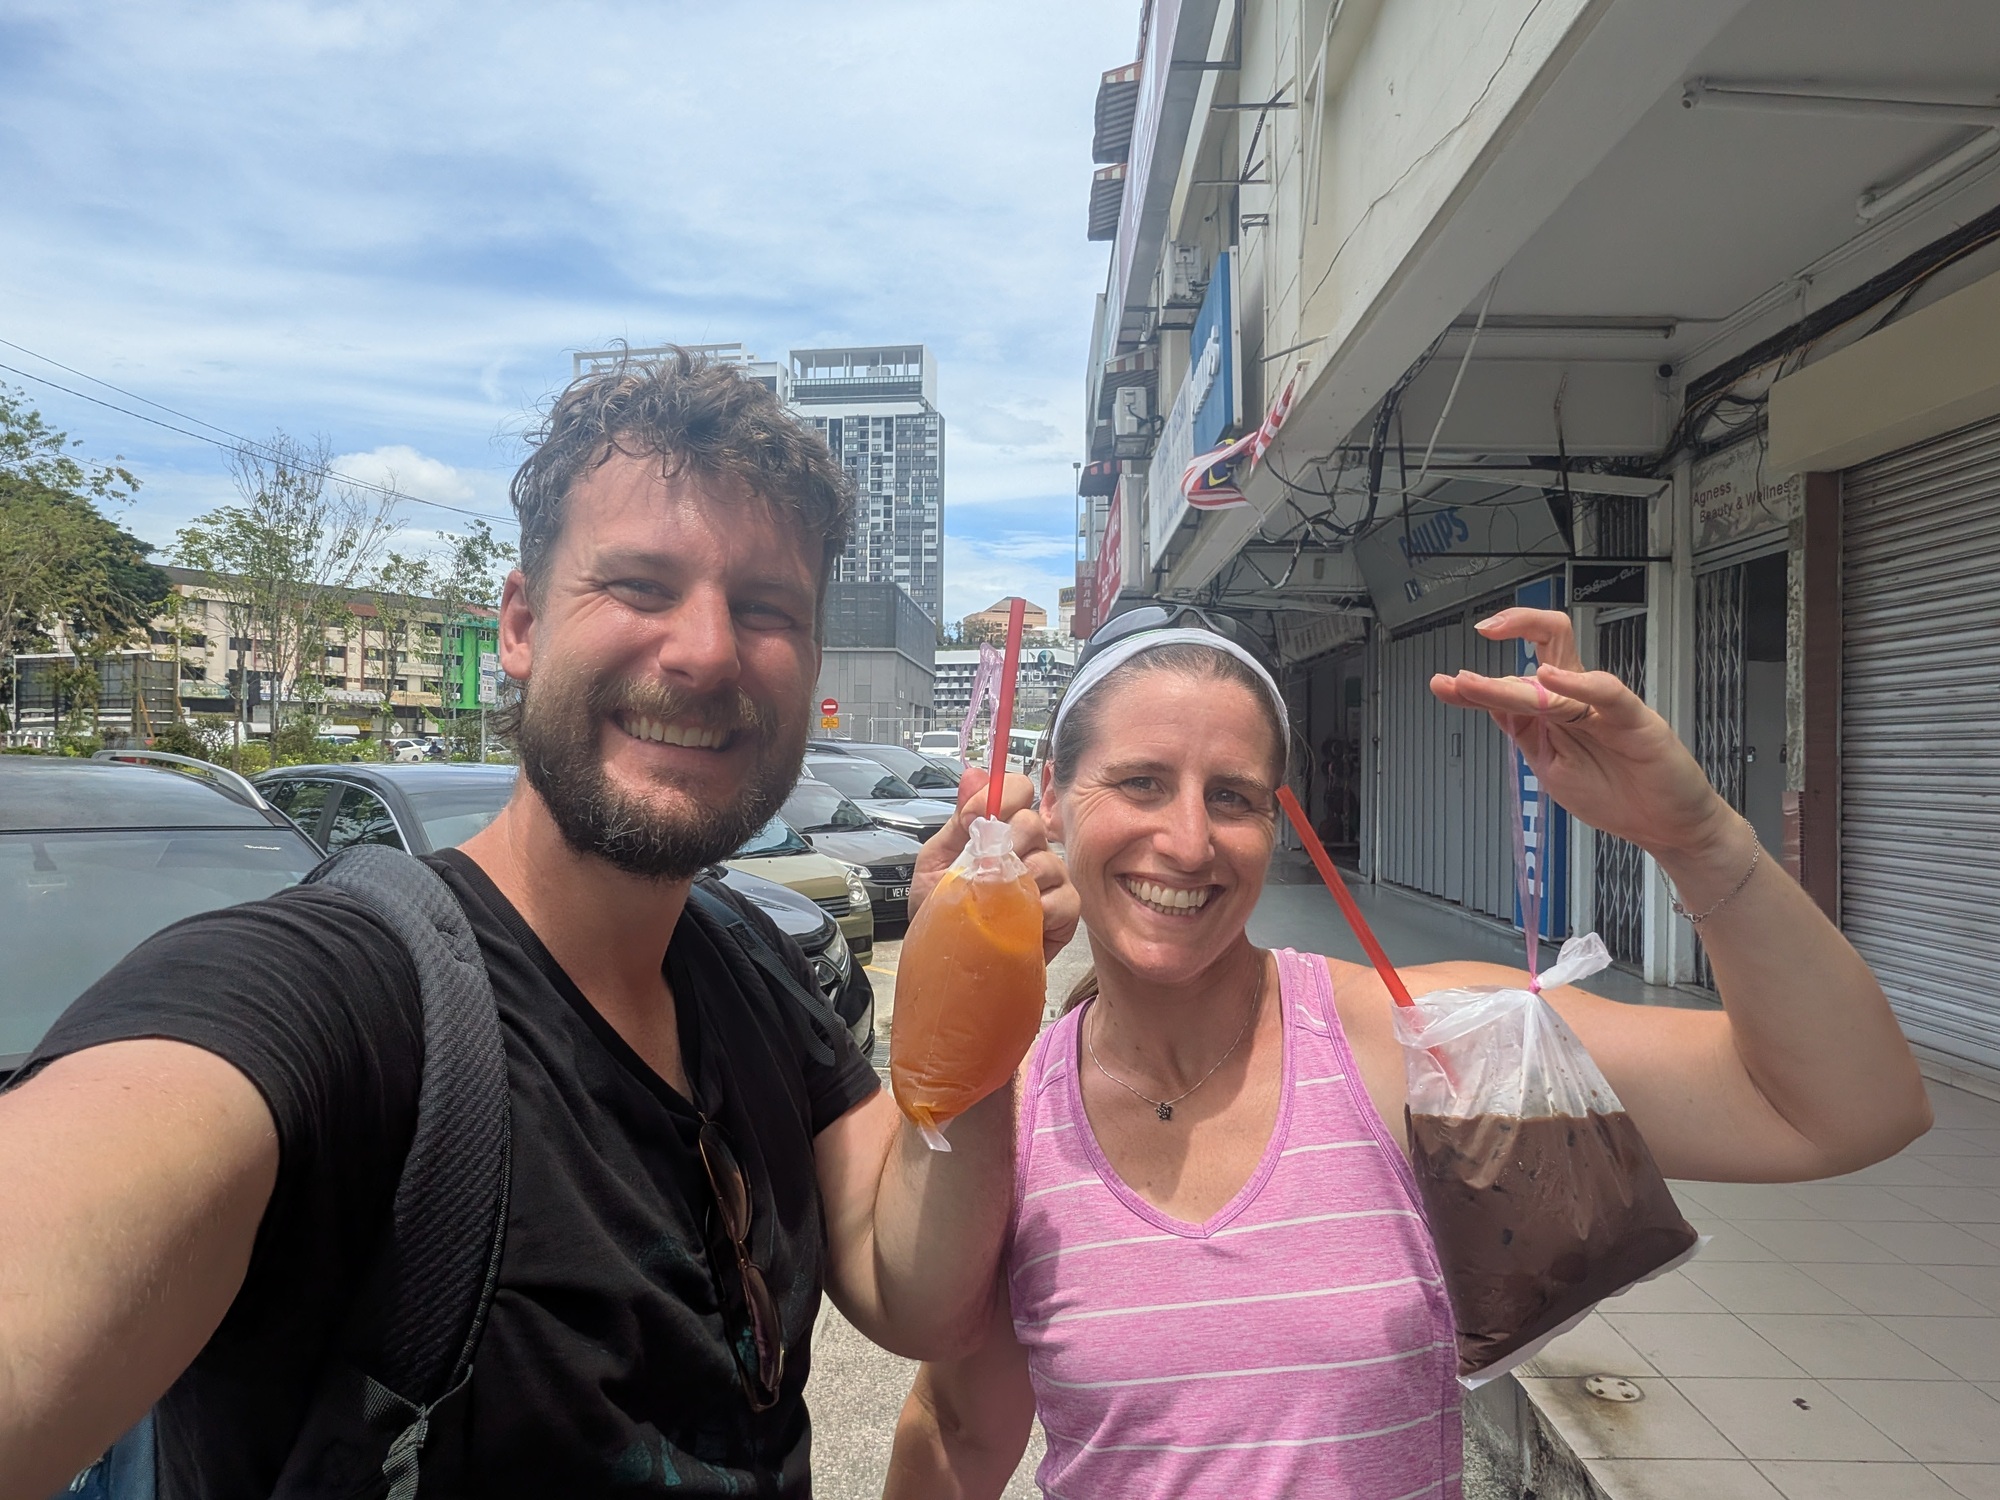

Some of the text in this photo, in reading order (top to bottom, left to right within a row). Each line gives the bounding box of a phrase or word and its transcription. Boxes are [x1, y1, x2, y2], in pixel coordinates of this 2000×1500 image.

[1693, 482, 1731, 507] Agness
[1700, 481, 1791, 523] Beauty & Wellnes
[1398, 505, 1469, 568] PHILIPS
[892, 887, 904, 898] VEY
